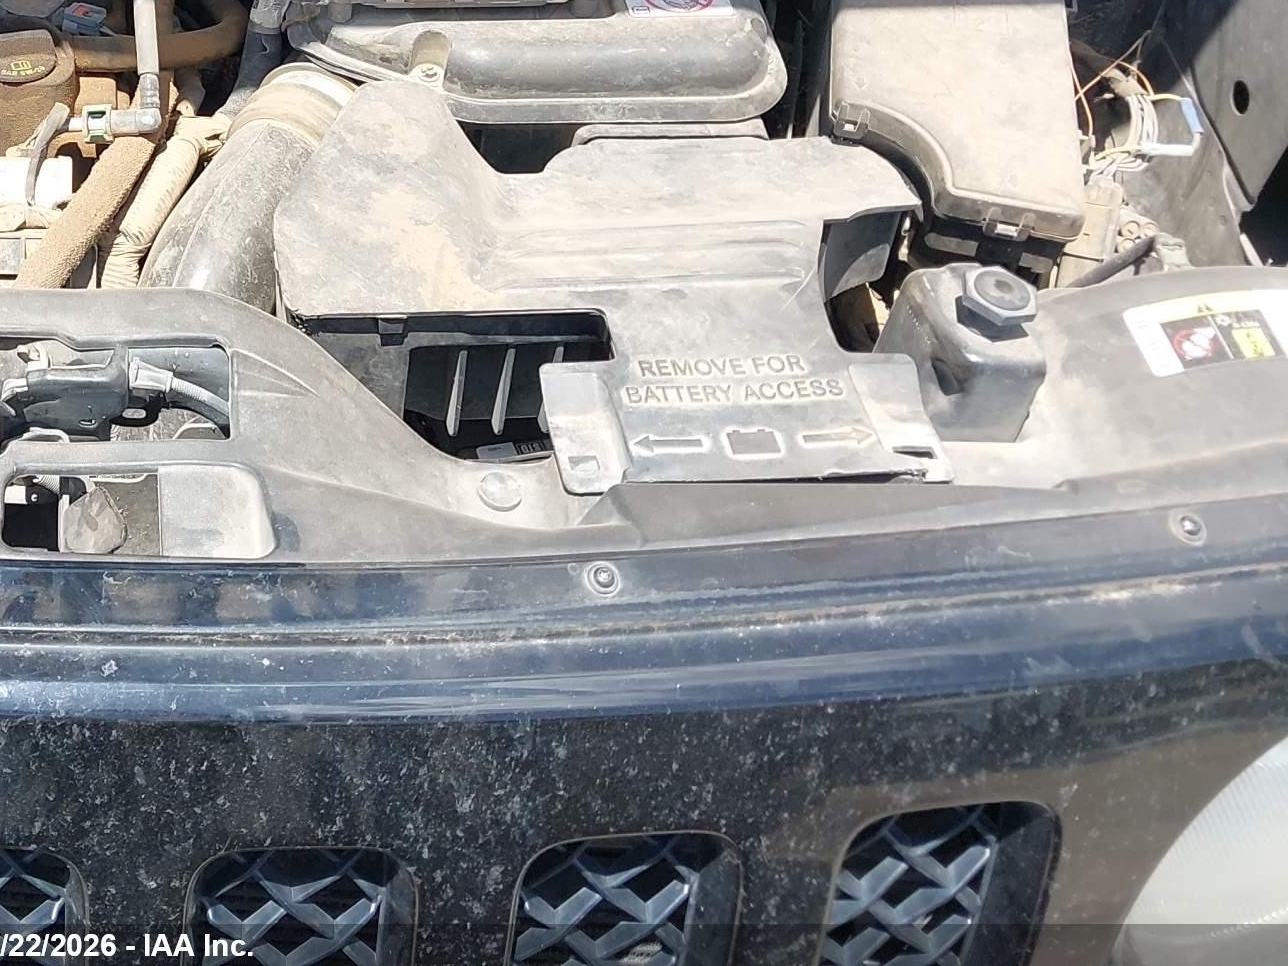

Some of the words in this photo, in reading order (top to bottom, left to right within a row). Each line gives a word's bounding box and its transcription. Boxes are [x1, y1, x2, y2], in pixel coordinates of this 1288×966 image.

[637, 357, 746, 378] REMOVE
[751, 354, 806, 374] FOR
[624, 384, 732, 404] BATTERY
[743, 378, 844, 402] ACCESS
